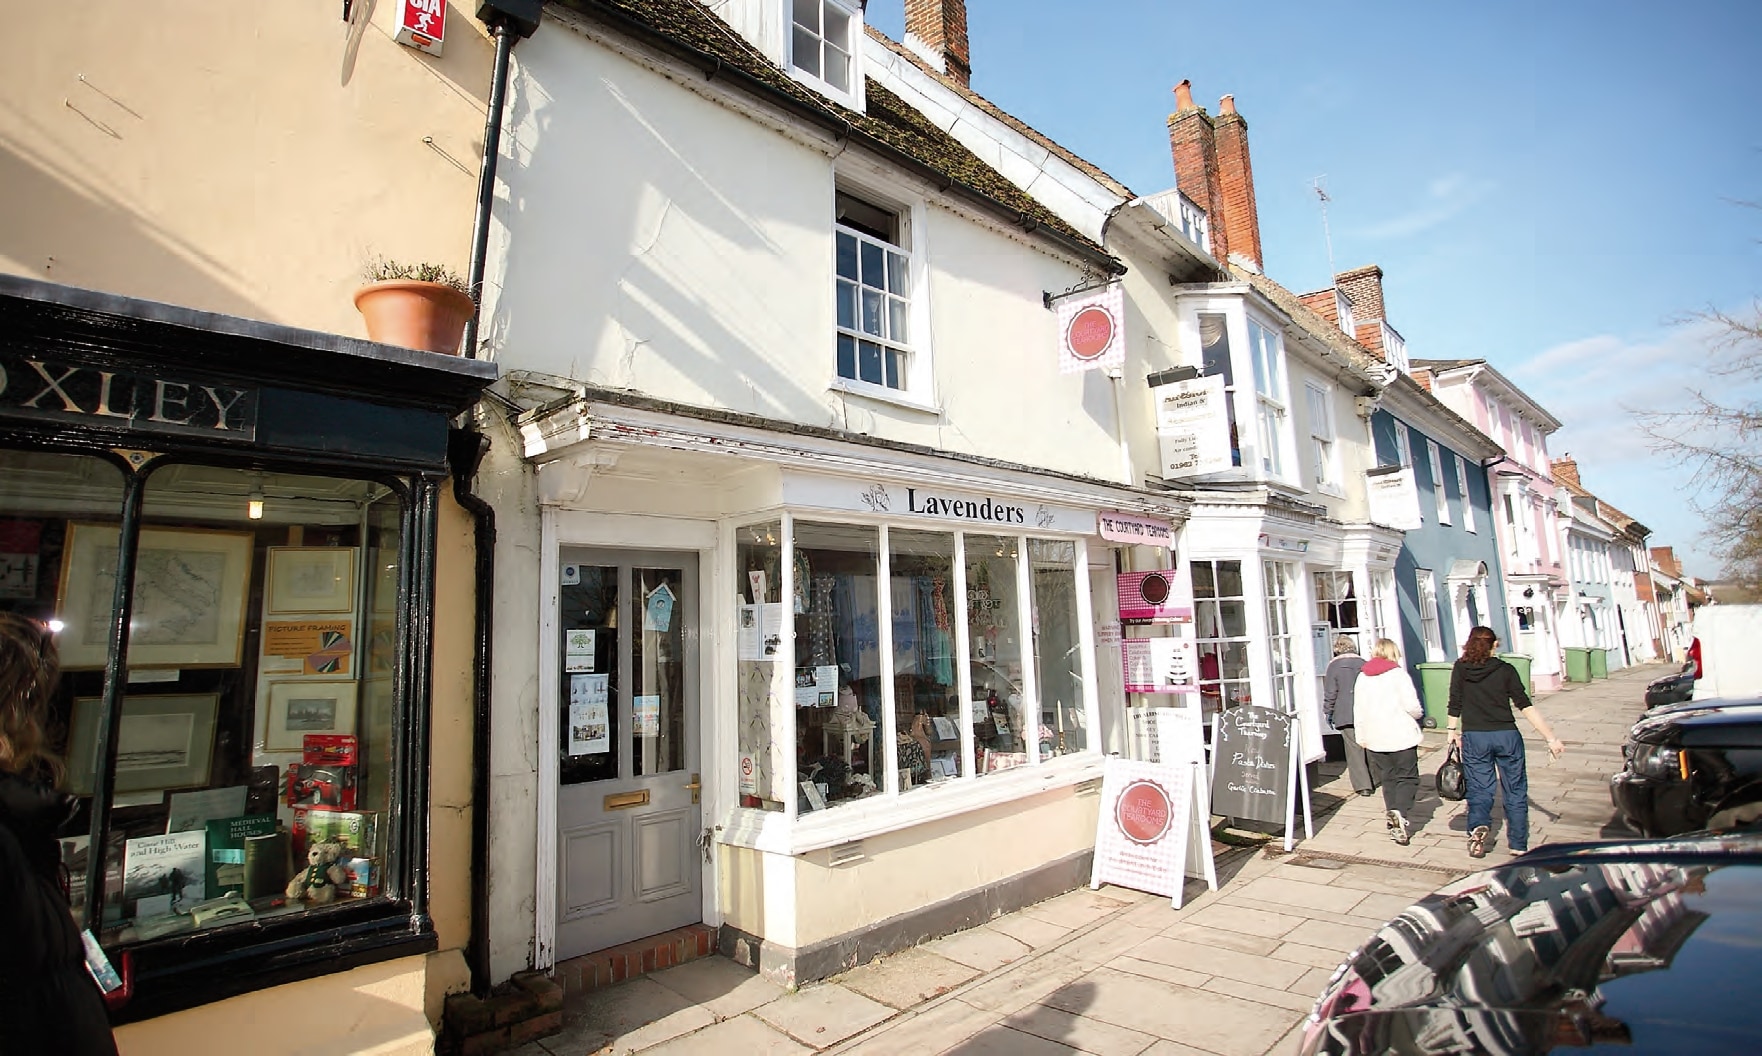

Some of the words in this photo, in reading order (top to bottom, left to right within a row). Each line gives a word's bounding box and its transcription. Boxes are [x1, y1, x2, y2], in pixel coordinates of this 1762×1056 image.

[0, 359, 248, 431] XLEY
[906, 487, 1024, 524] Lavenders
[1102, 518, 1114, 532] THE
[1115, 520, 1144, 536] COURTYARD
[1145, 524, 1170, 539] TEAROOMS
[268, 624, 305, 632] PICTURE
[1235, 716, 1270, 732] Courtyard
[1232, 752, 1255, 766] Pasta
[1227, 782, 1246, 792] Garlic
[1137, 798, 1152, 807] THE
[1121, 803, 1166, 818] COURTYARD
[230, 816, 271, 827] MEDIEVAL
[1123, 812, 1165, 826] TEAROOMS
[230, 825, 252, 833] HALL
[230, 829, 263, 839] HOUSES
[130, 847, 147, 857] and
[149, 846, 172, 856] High
[174, 842, 200, 851] Water
